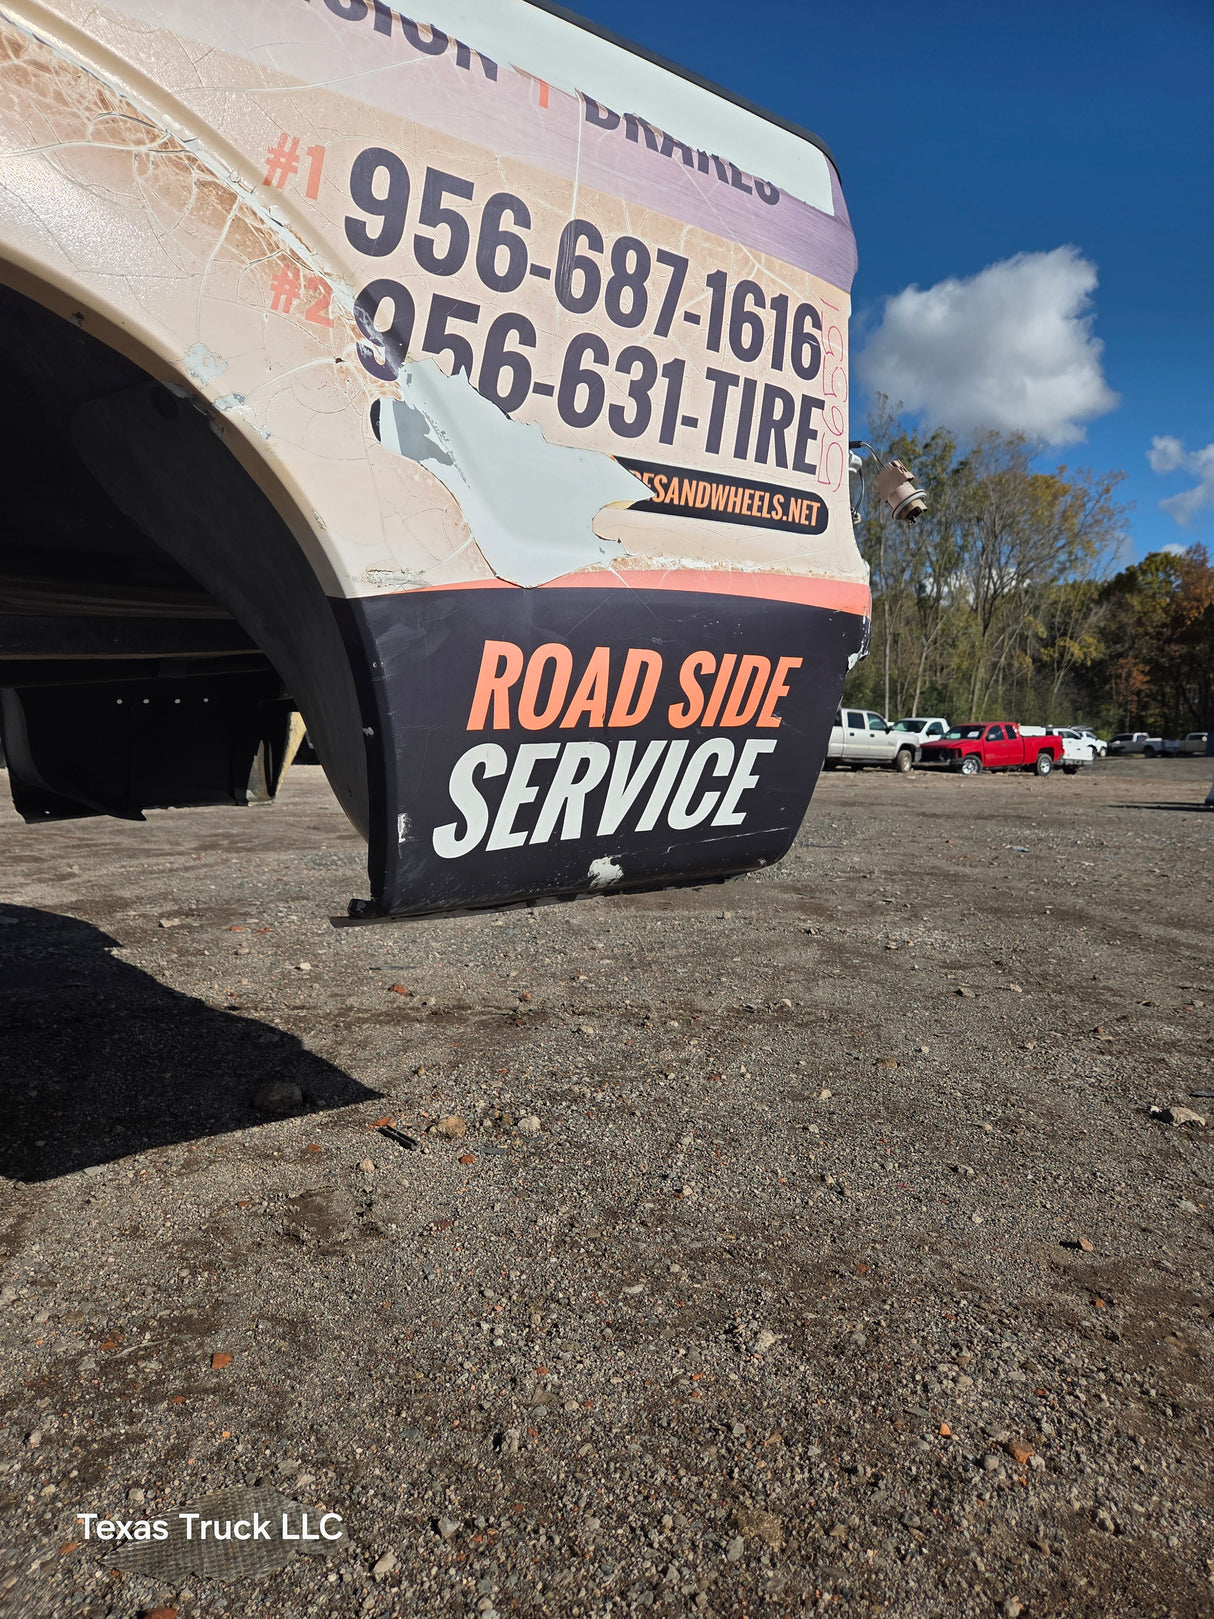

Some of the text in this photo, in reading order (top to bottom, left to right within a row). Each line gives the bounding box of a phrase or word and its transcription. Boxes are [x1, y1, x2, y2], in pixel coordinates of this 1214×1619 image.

[262, 132, 326, 200] #1
[344, 146, 823, 381] 956-687-1616
[270, 262, 826, 475] #2 956-631-TIRE
[629, 469, 821, 527] ESANDWHEELS.NET
[466, 640, 803, 731] ROAD SIDE
[432, 737, 777, 858] SERVICE
